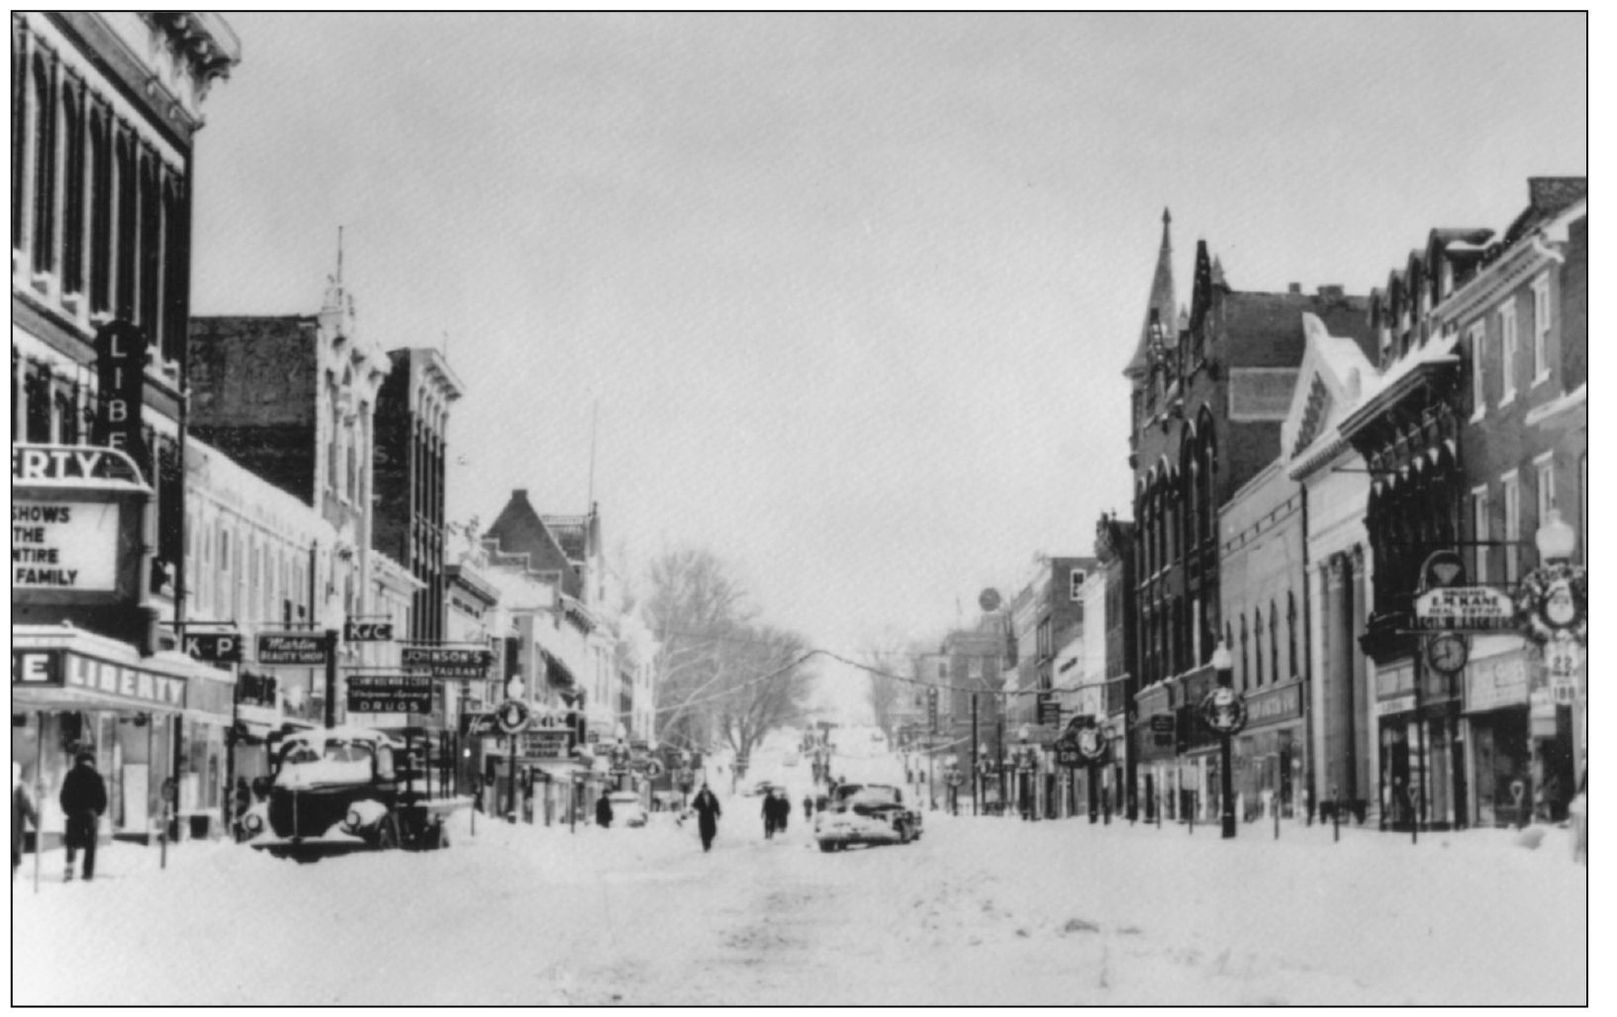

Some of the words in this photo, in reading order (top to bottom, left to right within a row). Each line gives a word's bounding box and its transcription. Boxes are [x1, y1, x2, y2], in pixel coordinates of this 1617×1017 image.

[14, 526, 45, 543] THE
[17, 568, 78, 585] FAMILY
[13, 653, 49, 681] E
[71, 655, 184, 704] LIBERTY
[360, 701, 419, 711] DRUGS
